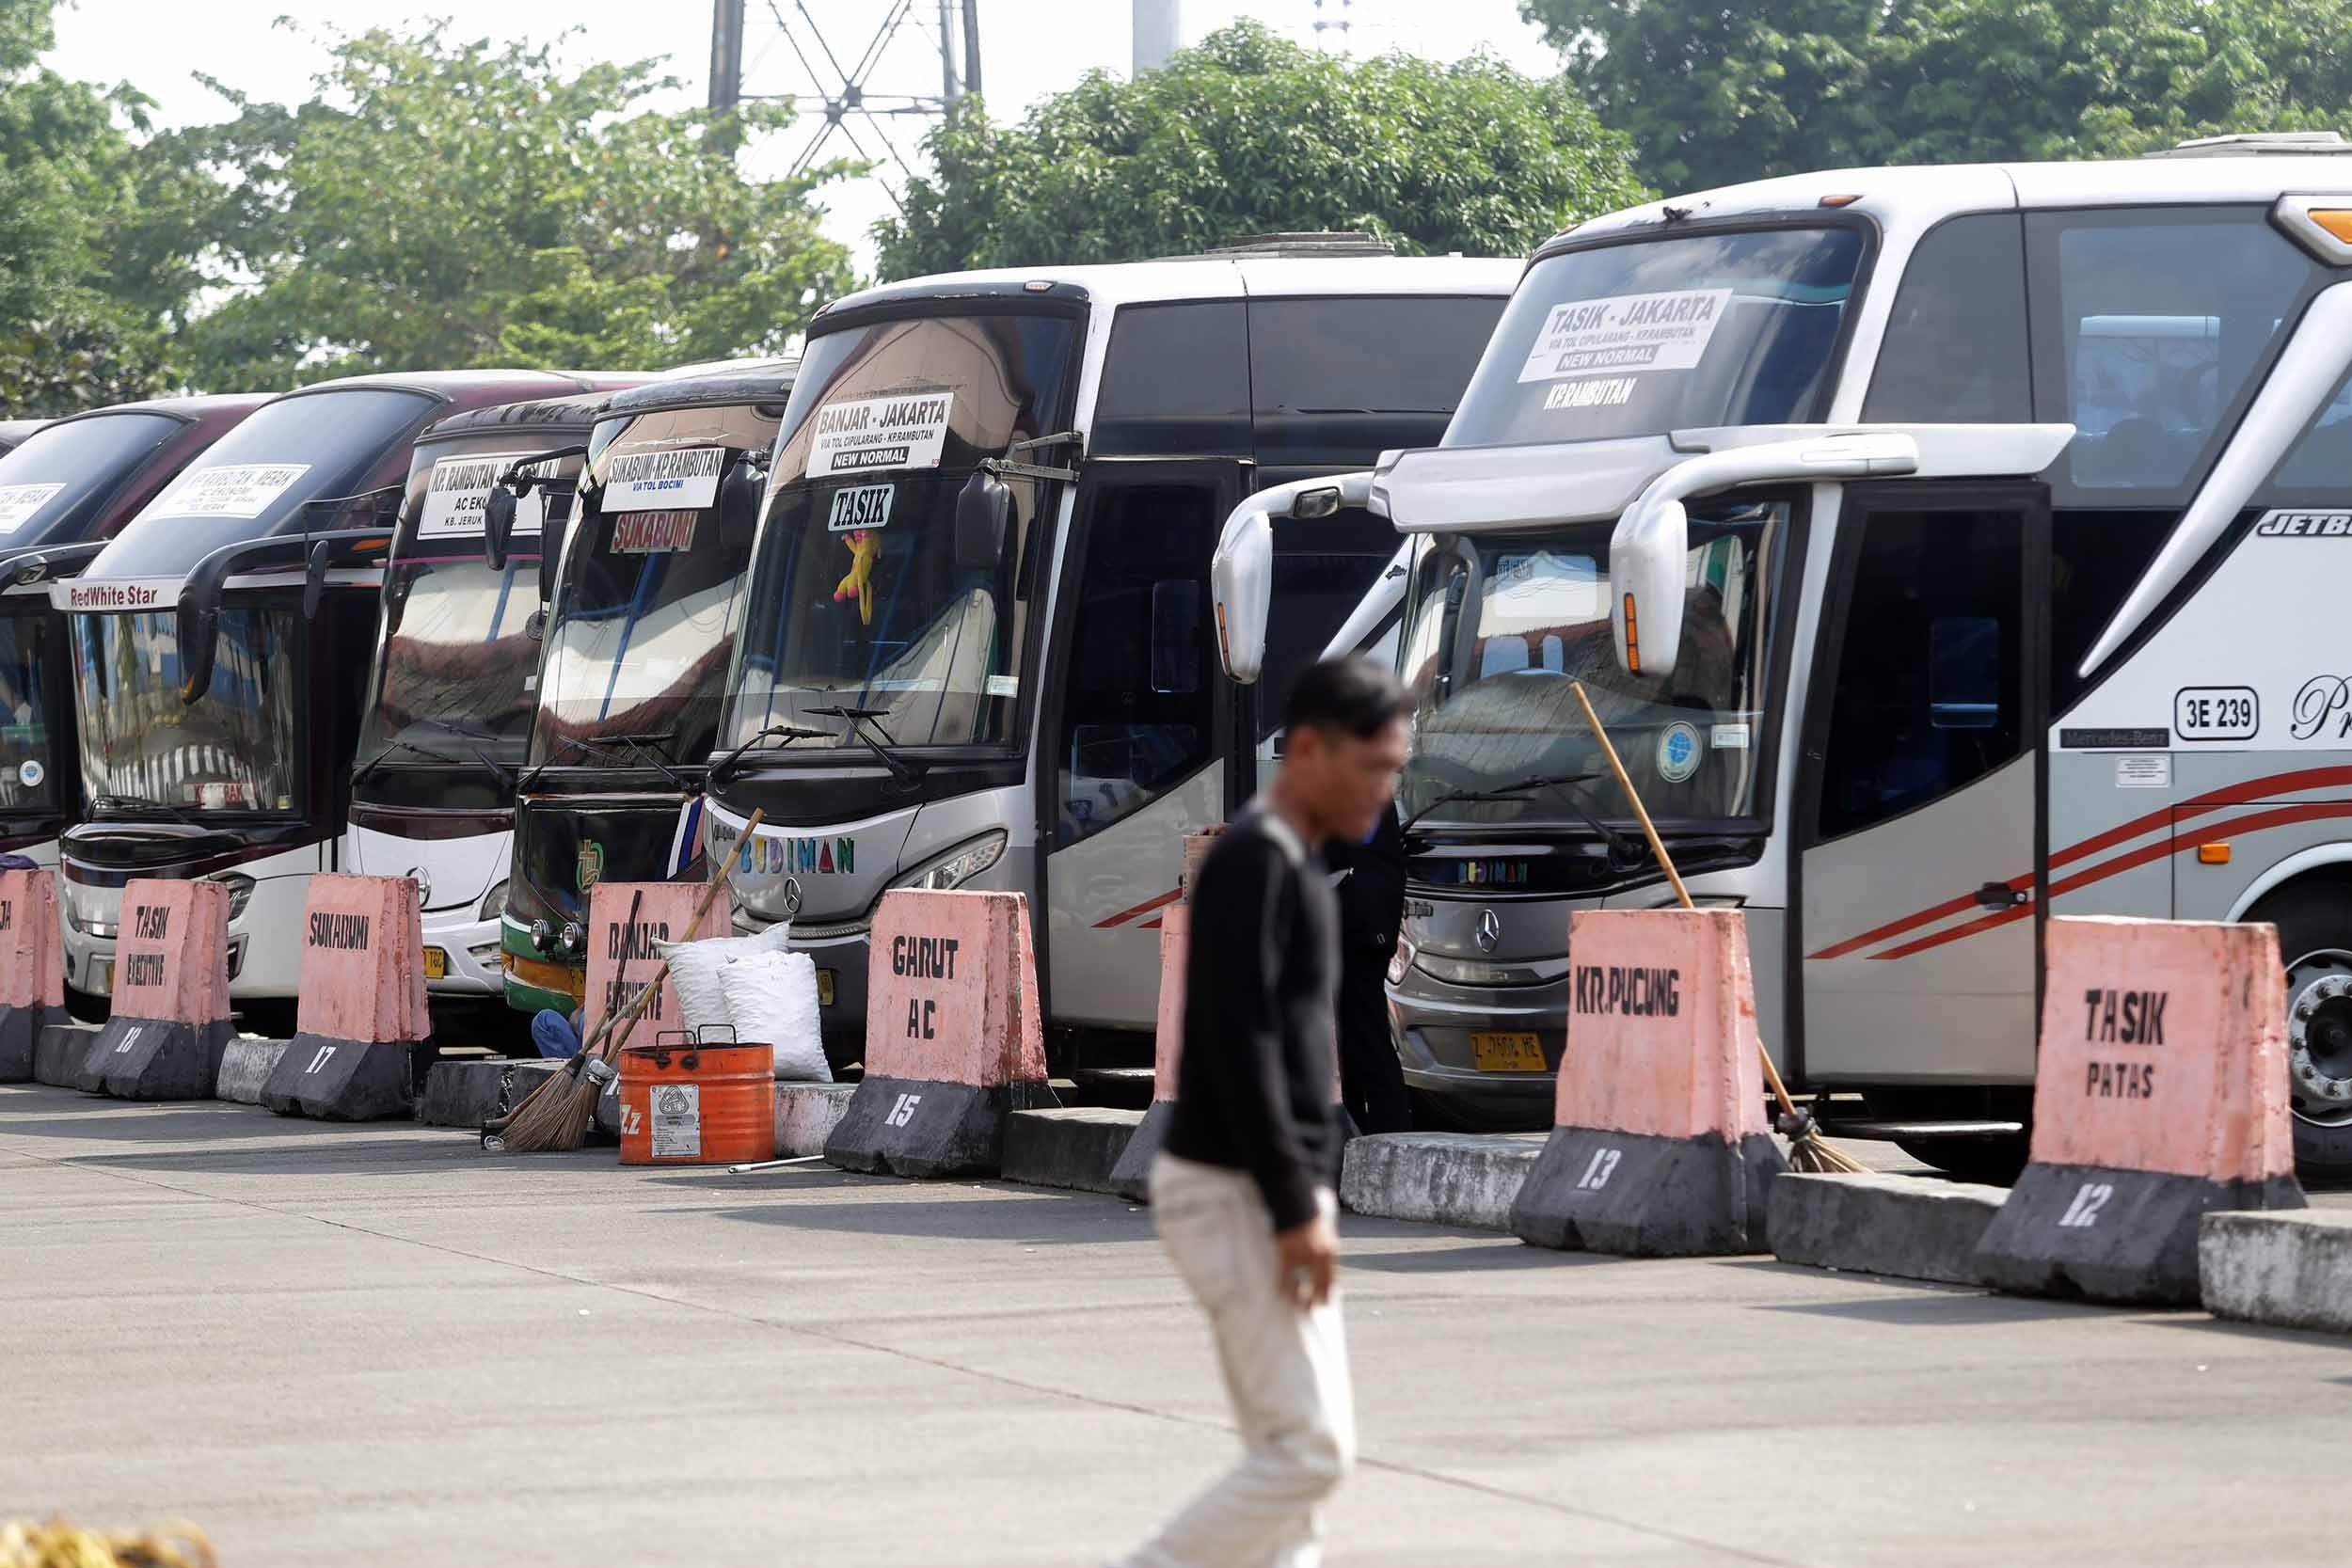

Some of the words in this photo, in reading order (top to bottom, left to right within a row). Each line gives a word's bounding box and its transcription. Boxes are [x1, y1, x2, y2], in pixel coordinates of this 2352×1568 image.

[1551, 304, 1611, 334] TASIK
[1619, 295, 1716, 325] JAKARTA
[1562, 351, 1593, 369] NEW
[1595, 347, 1653, 364] NORMAL
[818, 405, 870, 435] BANJAR
[880, 401, 945, 428] JAKARTA
[820, 438, 831, 450] VIA
[832, 436, 843, 448] TOL
[845, 433, 882, 446] CIPULARANG
[834, 453, 858, 467] NEW
[860, 450, 906, 465] NORMAL
[445, 464, 498, 491] RAMBUTAN
[632, 482, 643, 492] VIA
[644, 481, 657, 491] TOL
[659, 480, 684, 490] BOCIMI
[454, 497, 468, 511] AC
[459, 515, 482, 525] JERUK
[834, 488, 890, 527] TASIK
[613, 512, 695, 549] SUKABUMI
[2260, 515, 2352, 535] JETB
[71, 586, 124, 607] RedWhite
[128, 585, 158, 605] Star
[2186, 699, 2210, 727] 3E
[2217, 699, 2251, 727] 239
[740, 836, 855, 874] BUDIMAN
[135, 905, 170, 939] TASIK
[310, 911, 370, 951] SUKABUMI
[893, 935, 959, 979] GARUT
[907, 999, 935, 1039] AC
[2085, 989, 2168, 1045] TASIK
[115, 1026, 143, 1053] 18
[305, 1045, 337, 1074] 17
[2086, 1062, 2155, 1099] PATAS
[884, 1093, 921, 1127] 15
[1577, 1148, 1622, 1190] 13
[2058, 1183, 2114, 1227] 12
